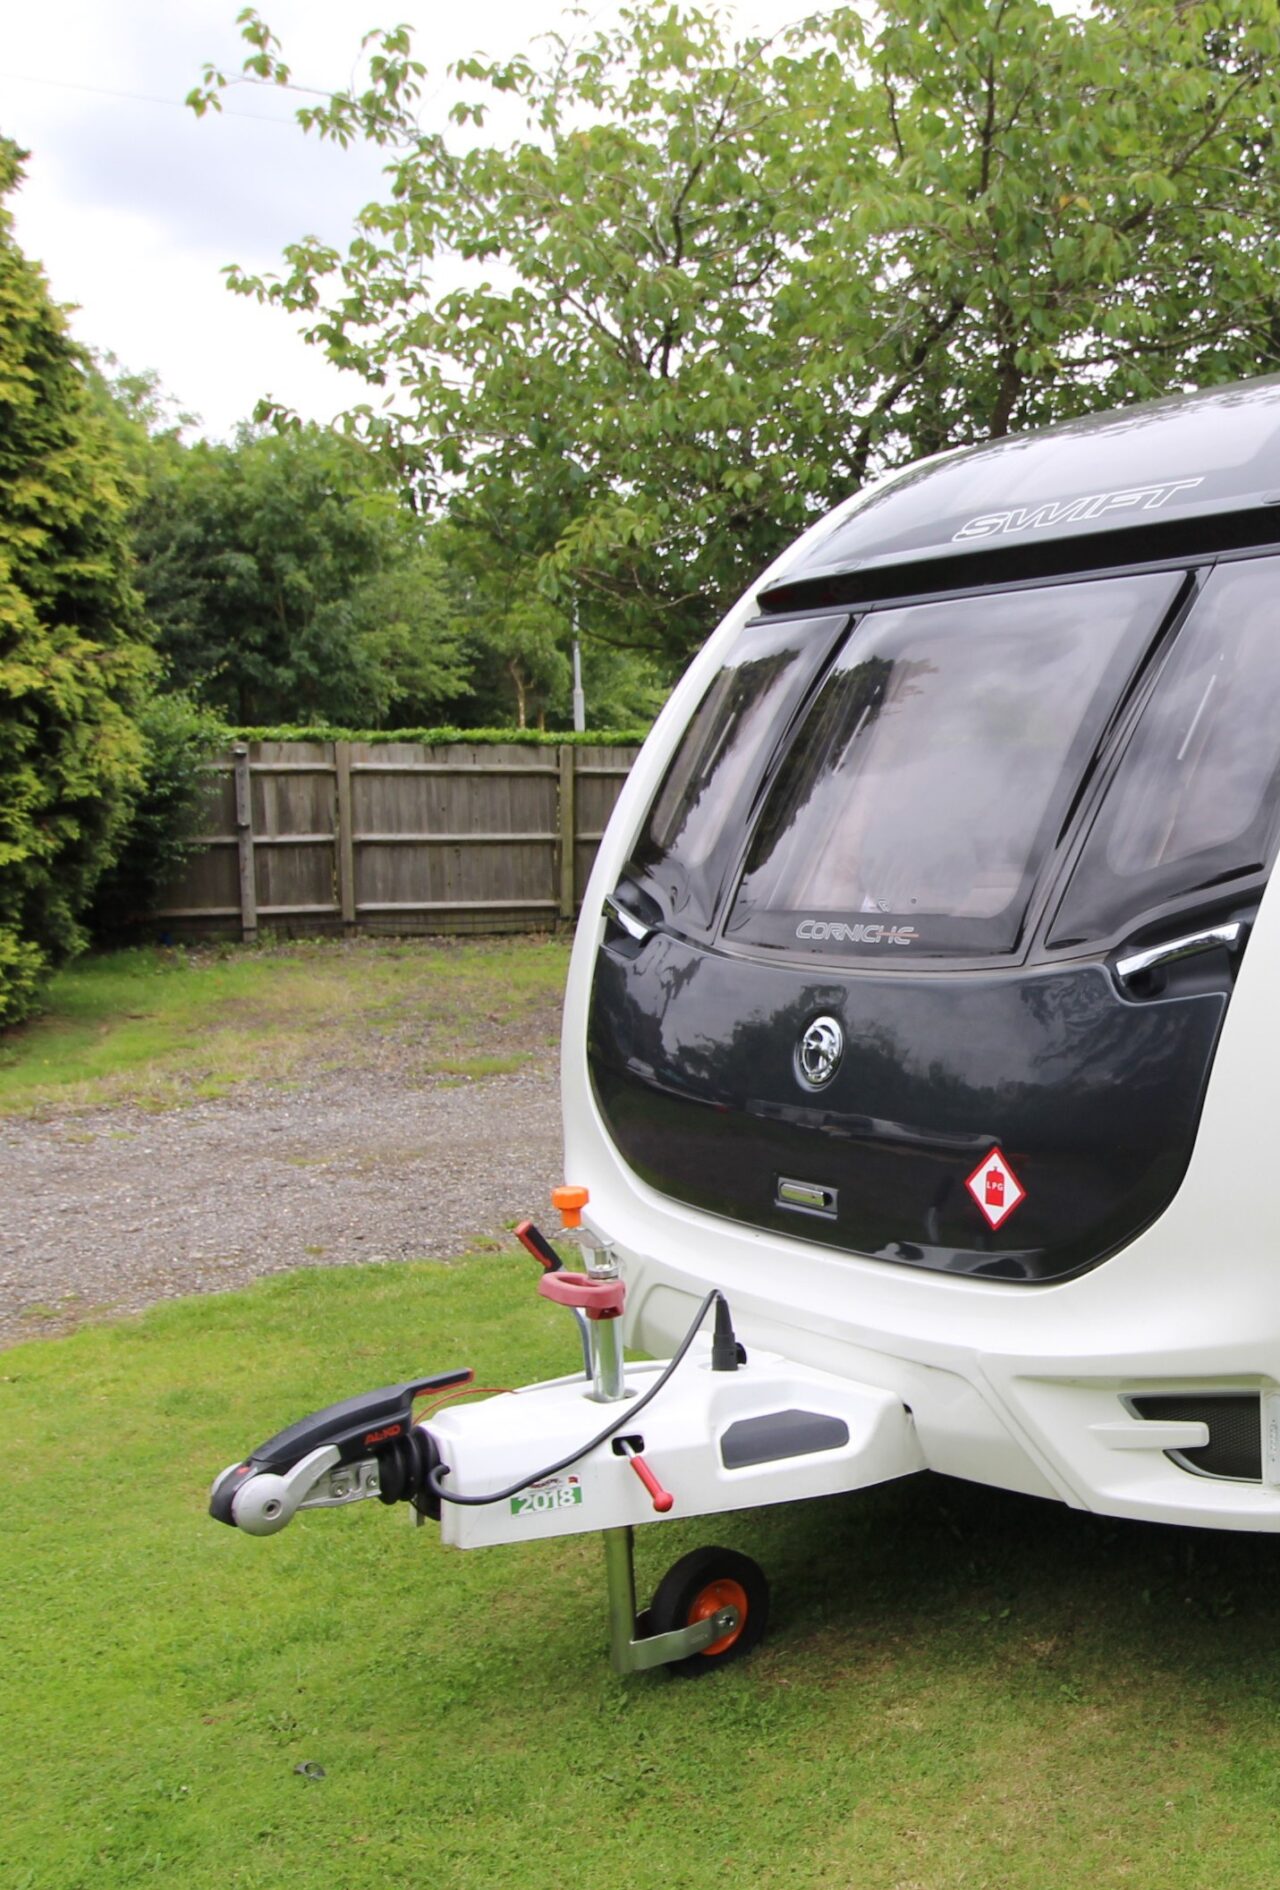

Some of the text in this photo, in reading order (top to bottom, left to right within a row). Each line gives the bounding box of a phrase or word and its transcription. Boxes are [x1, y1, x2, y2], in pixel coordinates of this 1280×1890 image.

[952, 476, 1205, 542] SWIFT
[796, 919, 919, 945] CORNICHE
[986, 1181, 1004, 1192] LPG
[518, 1487, 576, 1515] 2018
